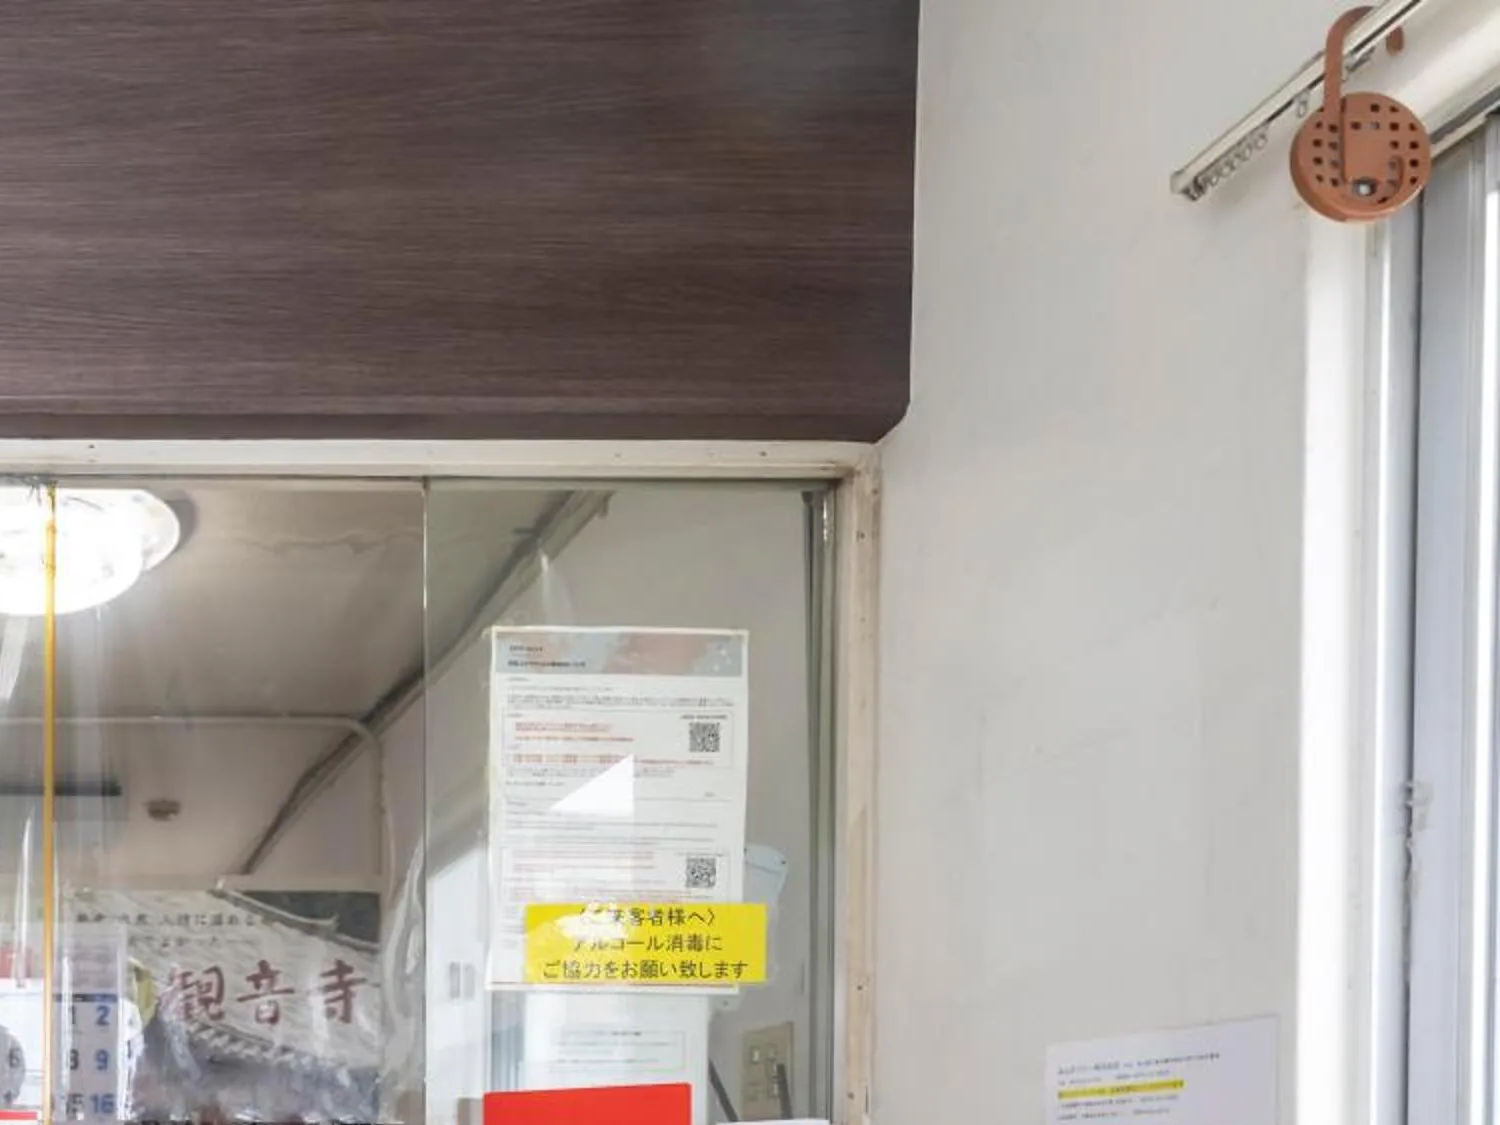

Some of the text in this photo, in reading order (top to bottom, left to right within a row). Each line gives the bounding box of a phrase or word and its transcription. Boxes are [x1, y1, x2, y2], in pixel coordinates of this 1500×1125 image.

[543, 960, 749, 980] ご協力をお願い致します
[162, 958, 370, 1025] 観音寺
[95, 1005, 110, 1026] 2
[95, 1049, 109, 1071] 9
[91, 1094, 115, 1114] 16
